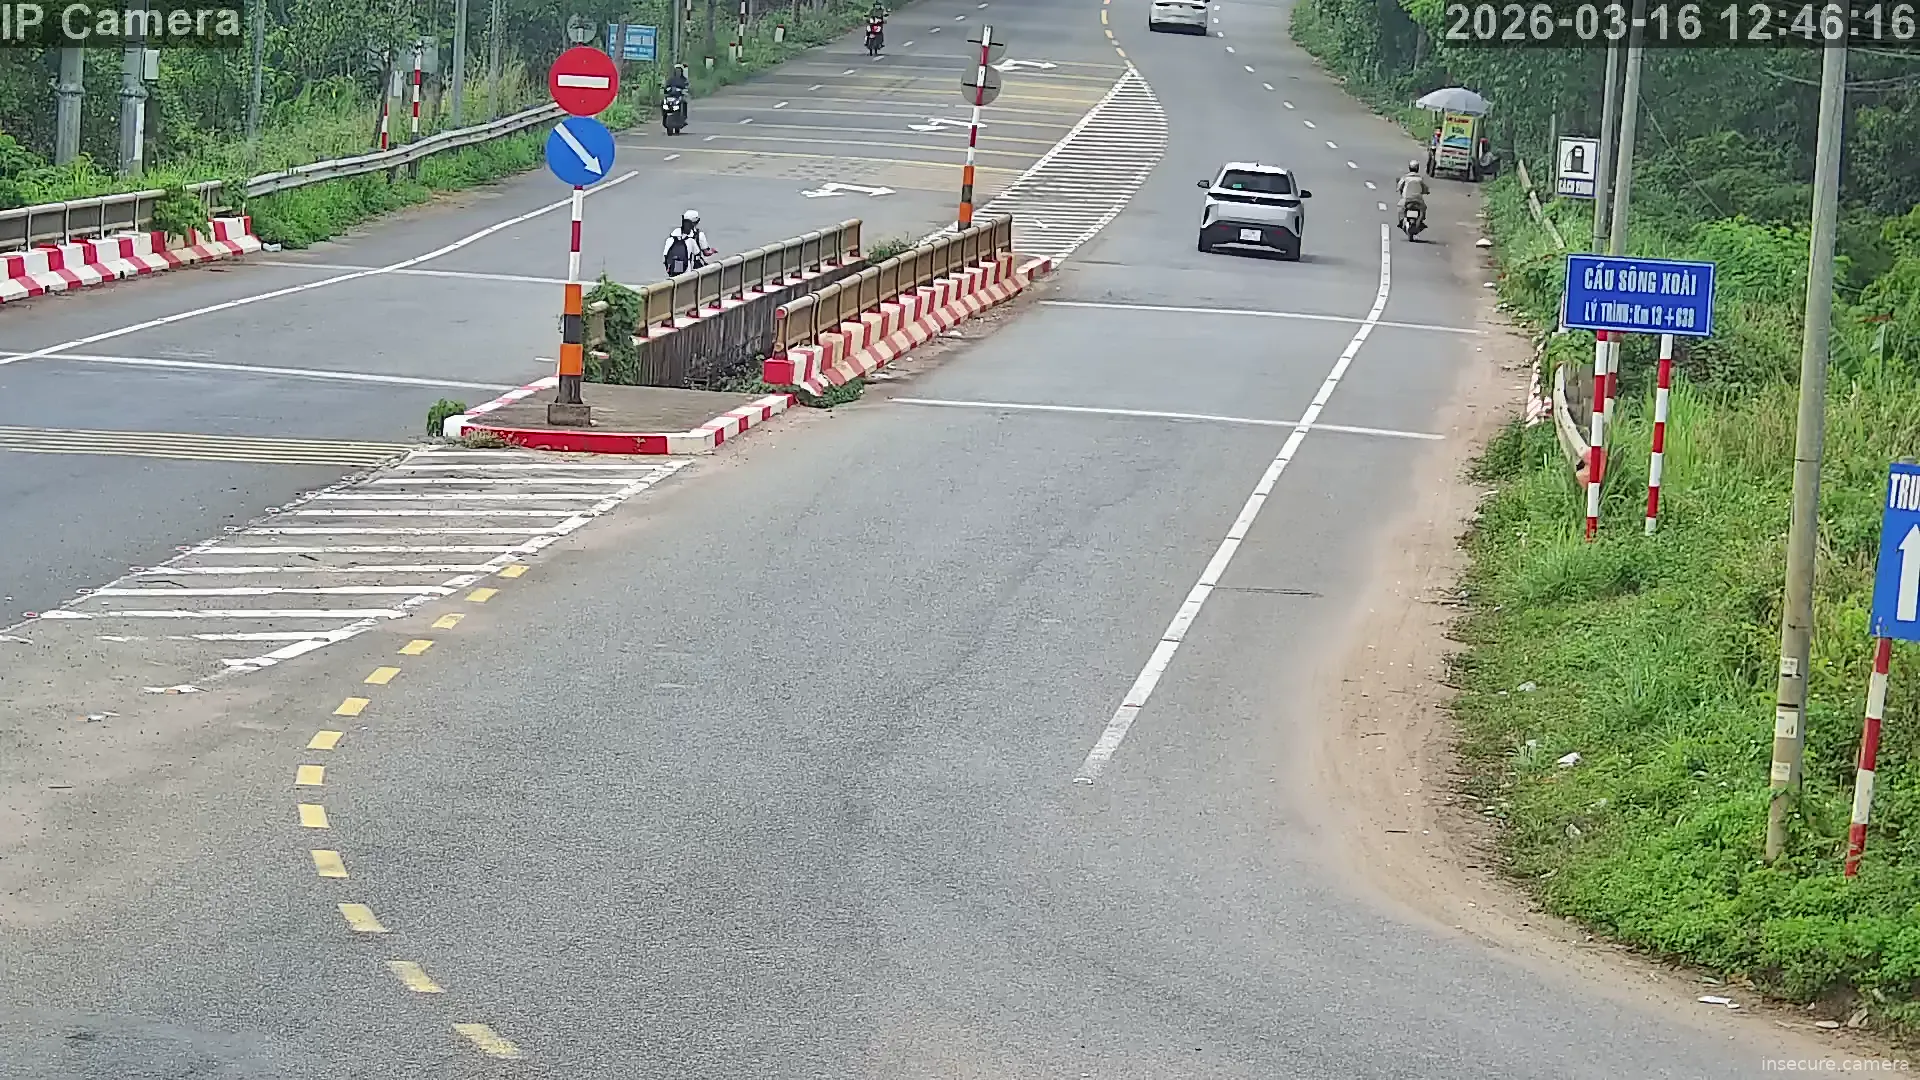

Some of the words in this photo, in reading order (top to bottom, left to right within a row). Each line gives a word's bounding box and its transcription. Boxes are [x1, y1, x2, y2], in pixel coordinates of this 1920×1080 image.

[1618, 265, 1657, 294] SÔNG
[1660, 269, 1697, 296] XOÀI
[1889, 472, 1920, 512] TRU
